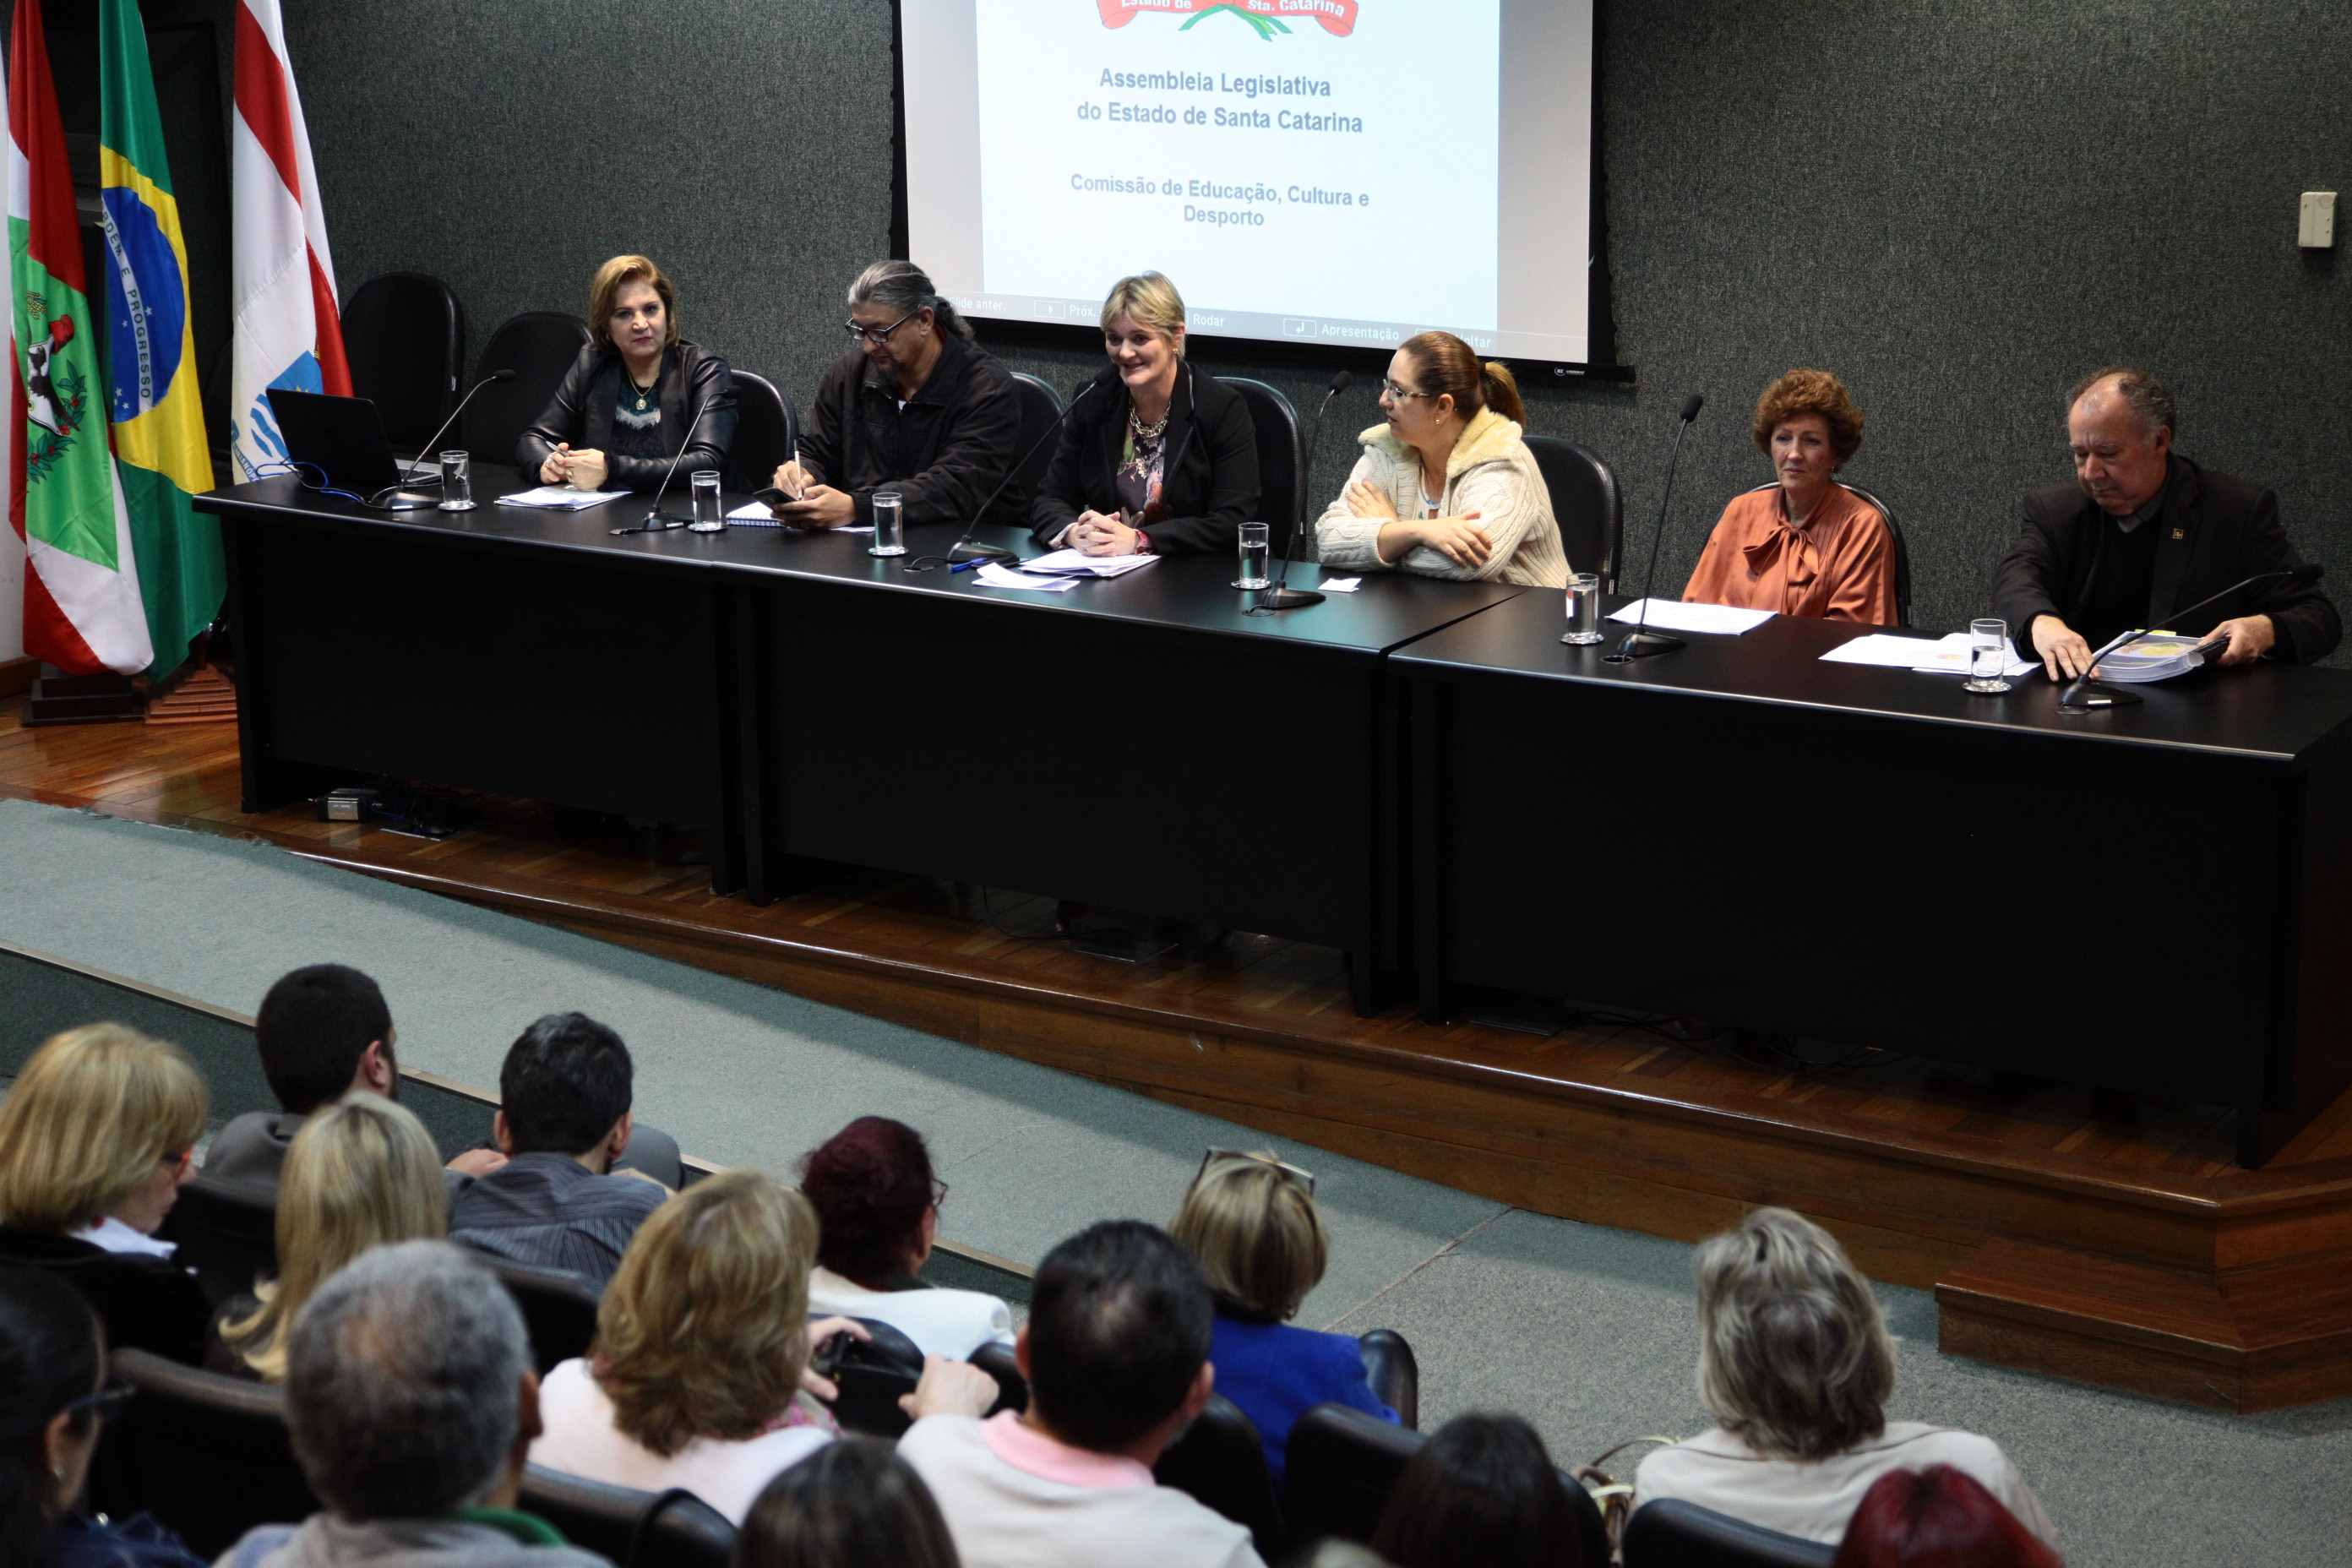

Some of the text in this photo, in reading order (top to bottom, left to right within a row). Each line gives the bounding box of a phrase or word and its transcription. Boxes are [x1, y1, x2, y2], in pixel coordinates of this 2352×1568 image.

[1174, 0, 1192, 8] de
[1247, 0, 1276, 11] Sta.
[1279, 0, 1345, 17] Catarina
[1099, 68, 1331, 99] Assembleia Legislativa
[1076, 101, 1363, 133] do Estado de Santa Catarina
[1070, 173, 1369, 207] Comissão de Educação, Cultura e
[1184, 204, 1265, 228] Desporto
[102, 211, 151, 398] RDEM E PROGRESSO
[976, 299, 1006, 312] anter.
[1070, 304, 1097, 318] Próx.
[1193, 313, 1225, 328] Rodar
[1321, 324, 1399, 342] Apresentação
